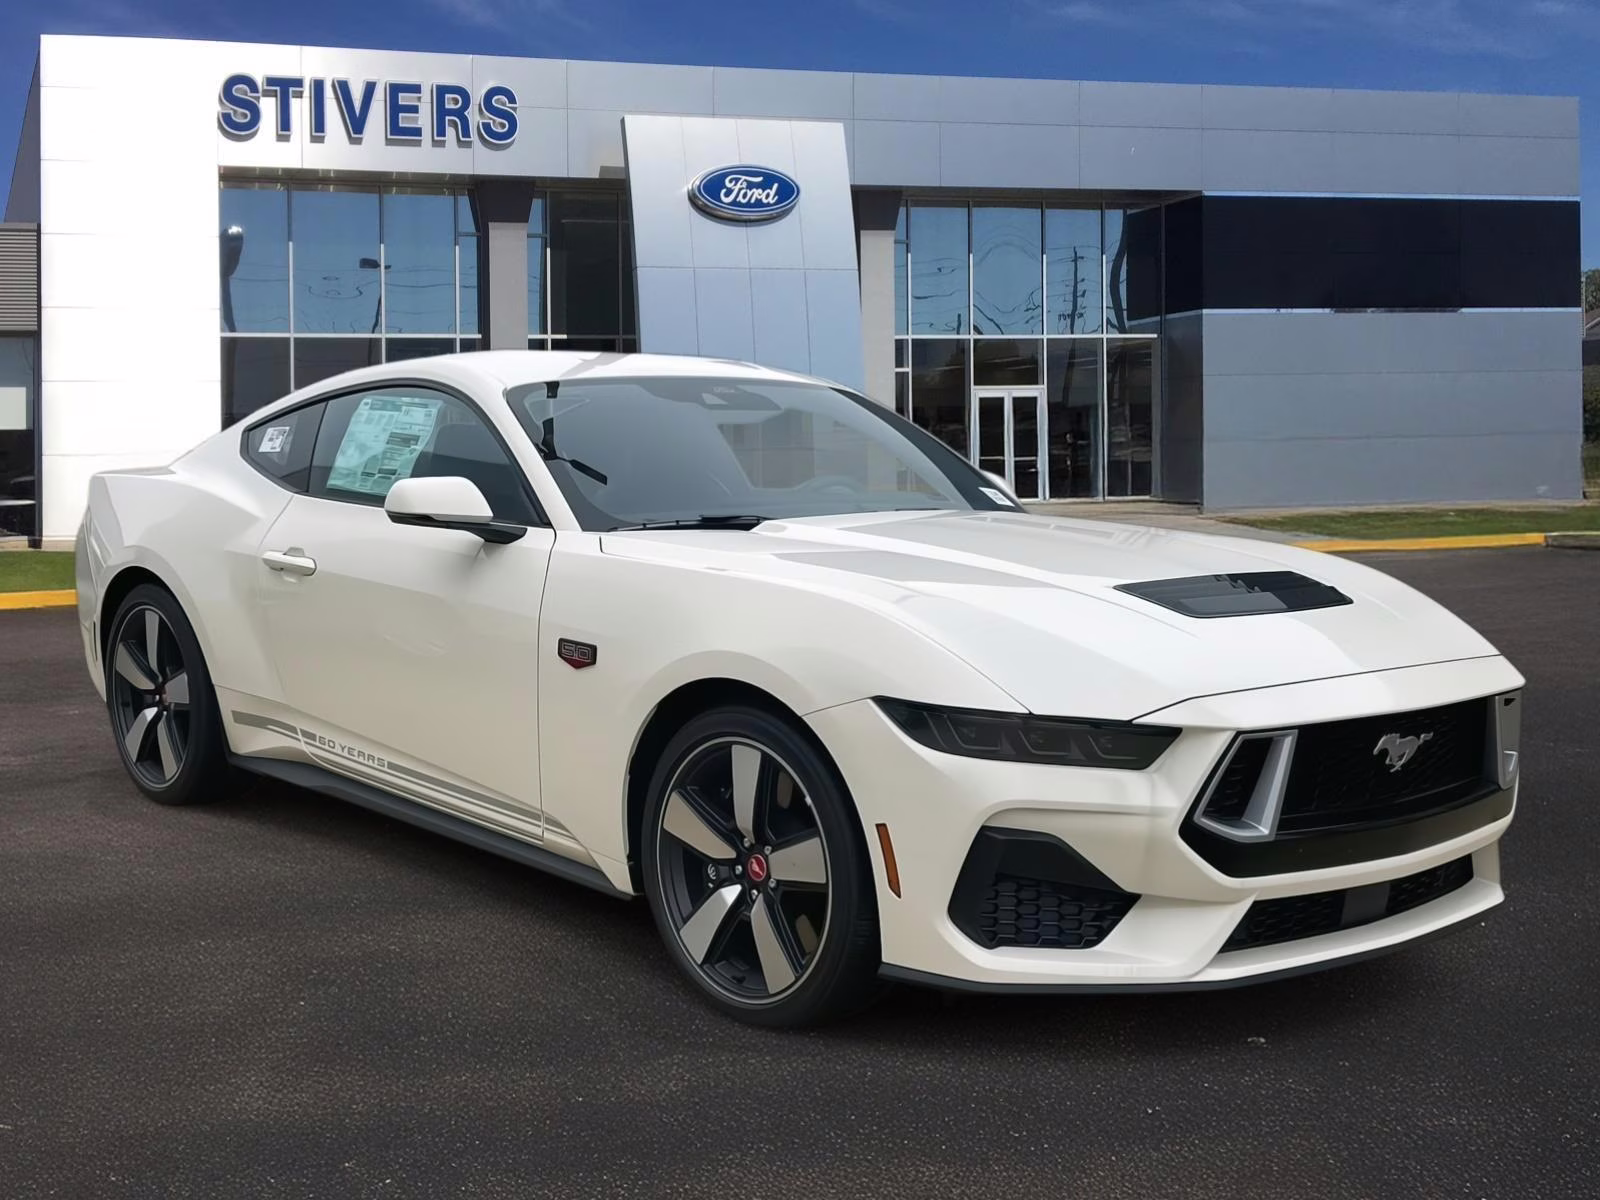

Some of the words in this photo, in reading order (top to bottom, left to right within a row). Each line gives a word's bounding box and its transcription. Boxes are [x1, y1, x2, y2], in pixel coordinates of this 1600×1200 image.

[218, 73, 519, 146] STIVERS
[720, 174, 779, 203] Ford
[318, 736, 336, 749] 60
[339, 744, 386, 767] YEARS
